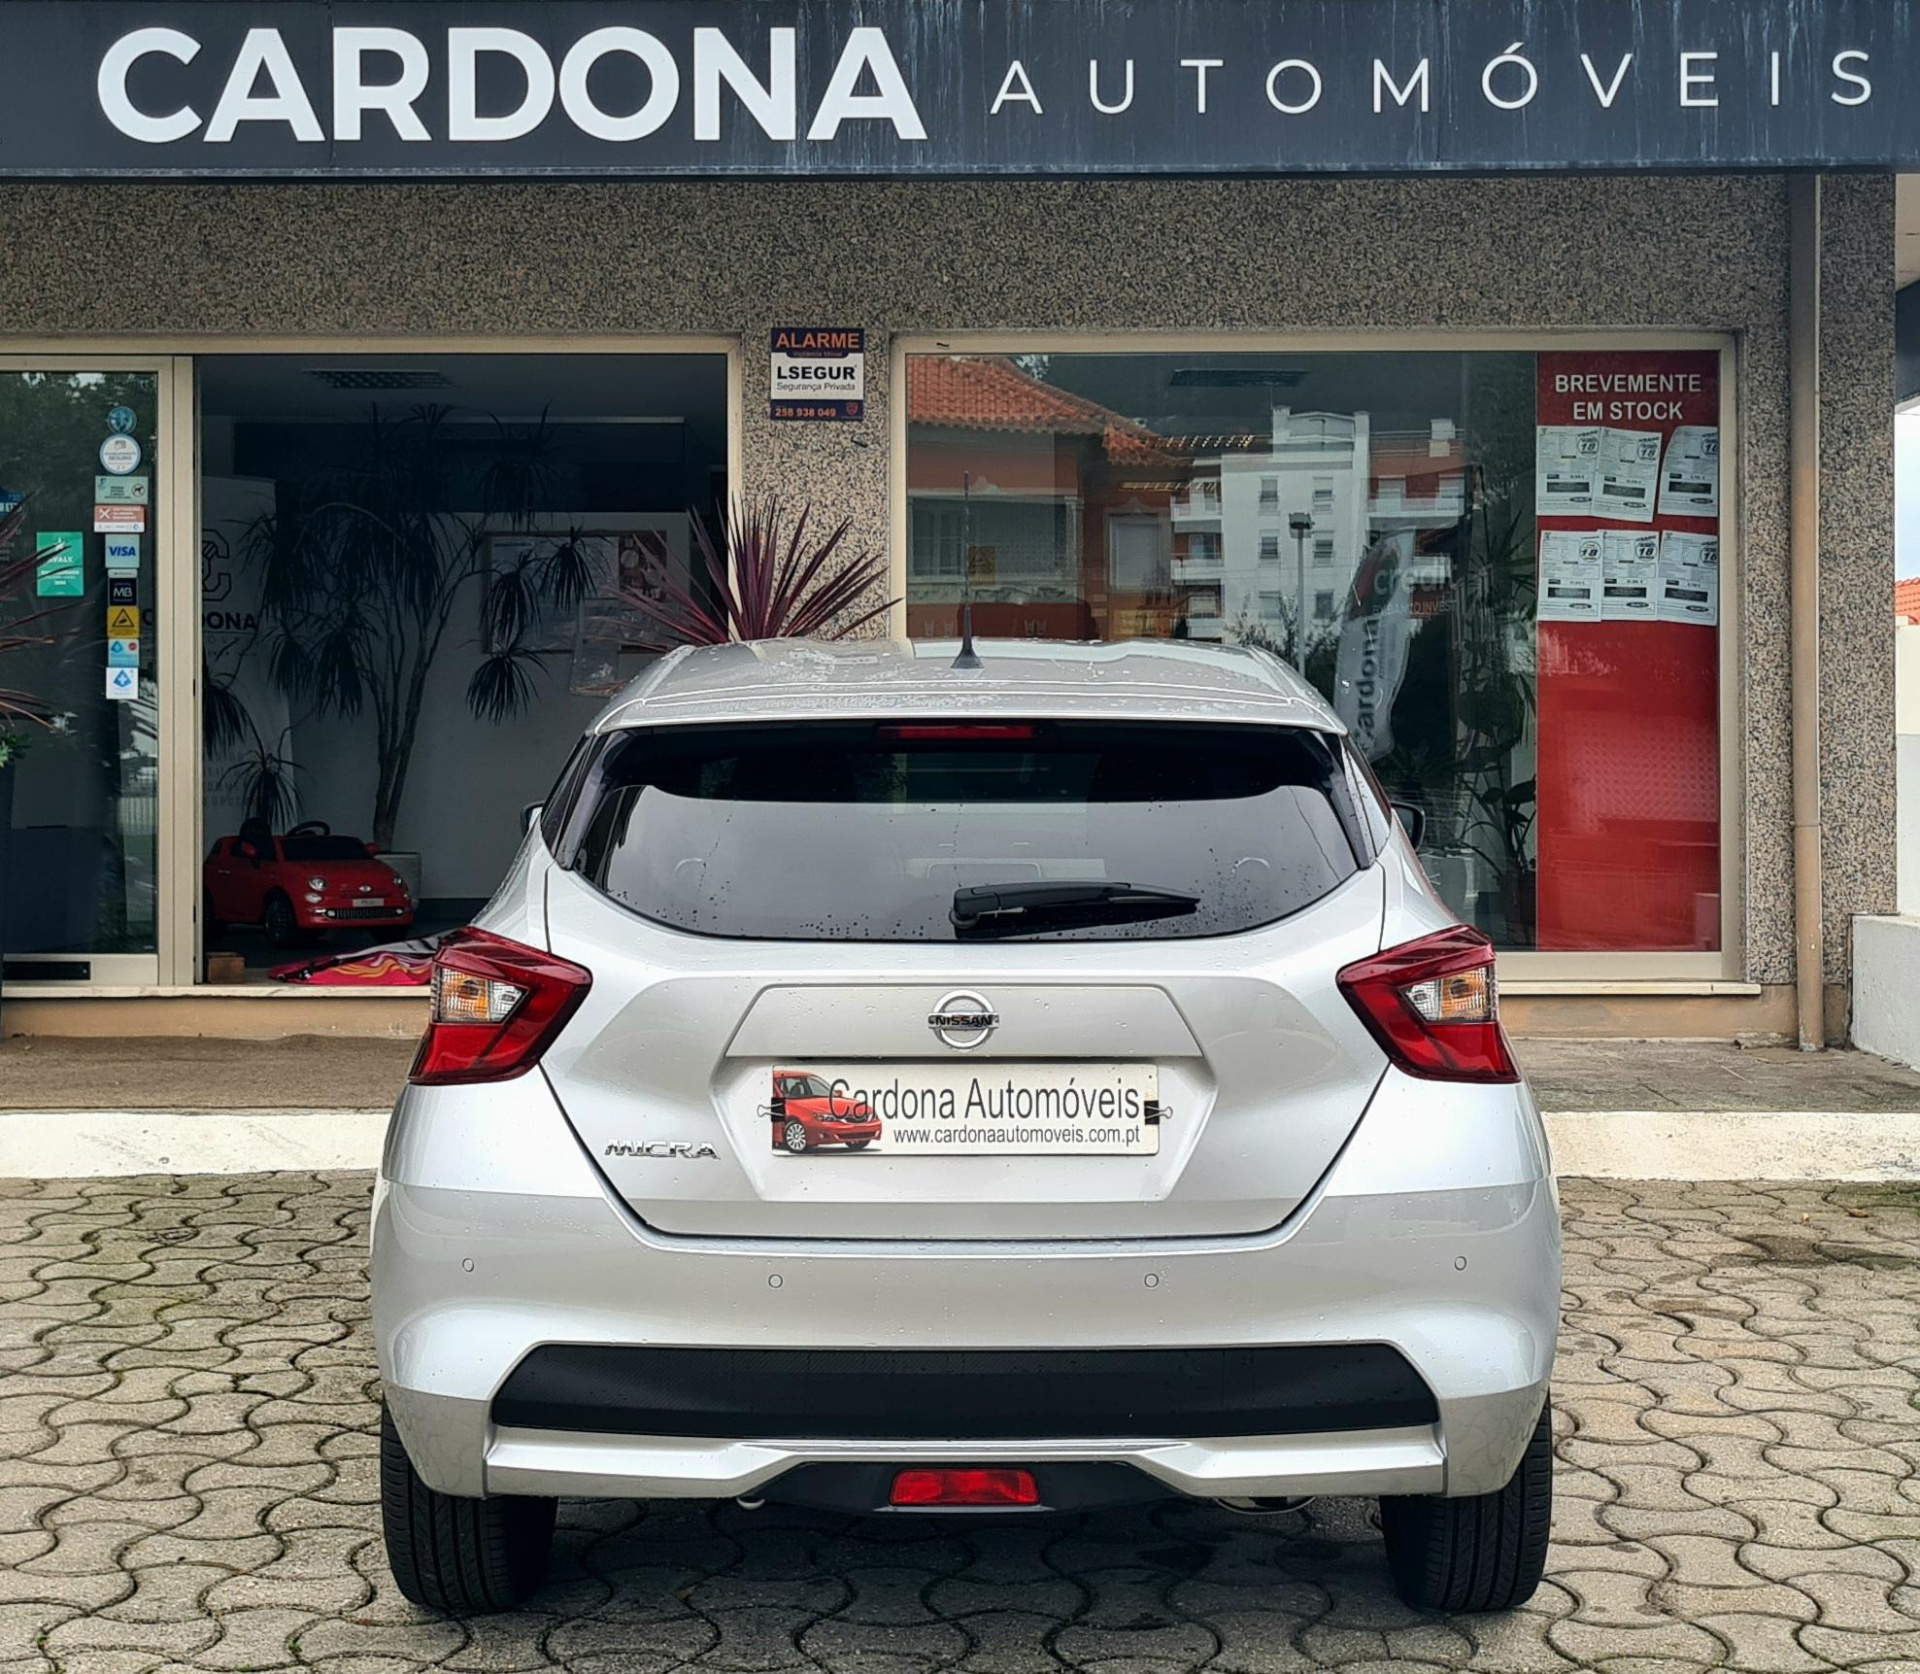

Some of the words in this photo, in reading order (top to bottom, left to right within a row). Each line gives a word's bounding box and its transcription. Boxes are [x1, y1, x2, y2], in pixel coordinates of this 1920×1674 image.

[97, 27, 928, 143] CARDONA
[990, 42, 1873, 115] AUTOMÓVEIS
[776, 332, 860, 349] ALARME
[777, 366, 855, 380] LSEGUR
[776, 382, 822, 393] Segurança
[824, 382, 856, 392] Privada
[1554, 374, 1702, 393] BREVEMENTE
[1572, 402, 1603, 421] EM
[1610, 402, 1683, 421] STOCK
[109, 546, 136, 557] VISA
[113, 587, 133, 598] MB
[934, 1014, 994, 1026] NISSAN
[829, 1078, 955, 1119] Cardona
[964, 1078, 1140, 1119] Automóveis
[893, 1124, 1140, 1147] www.cardonaautomoveis.com.pt
[604, 1140, 721, 1160] MICRA
